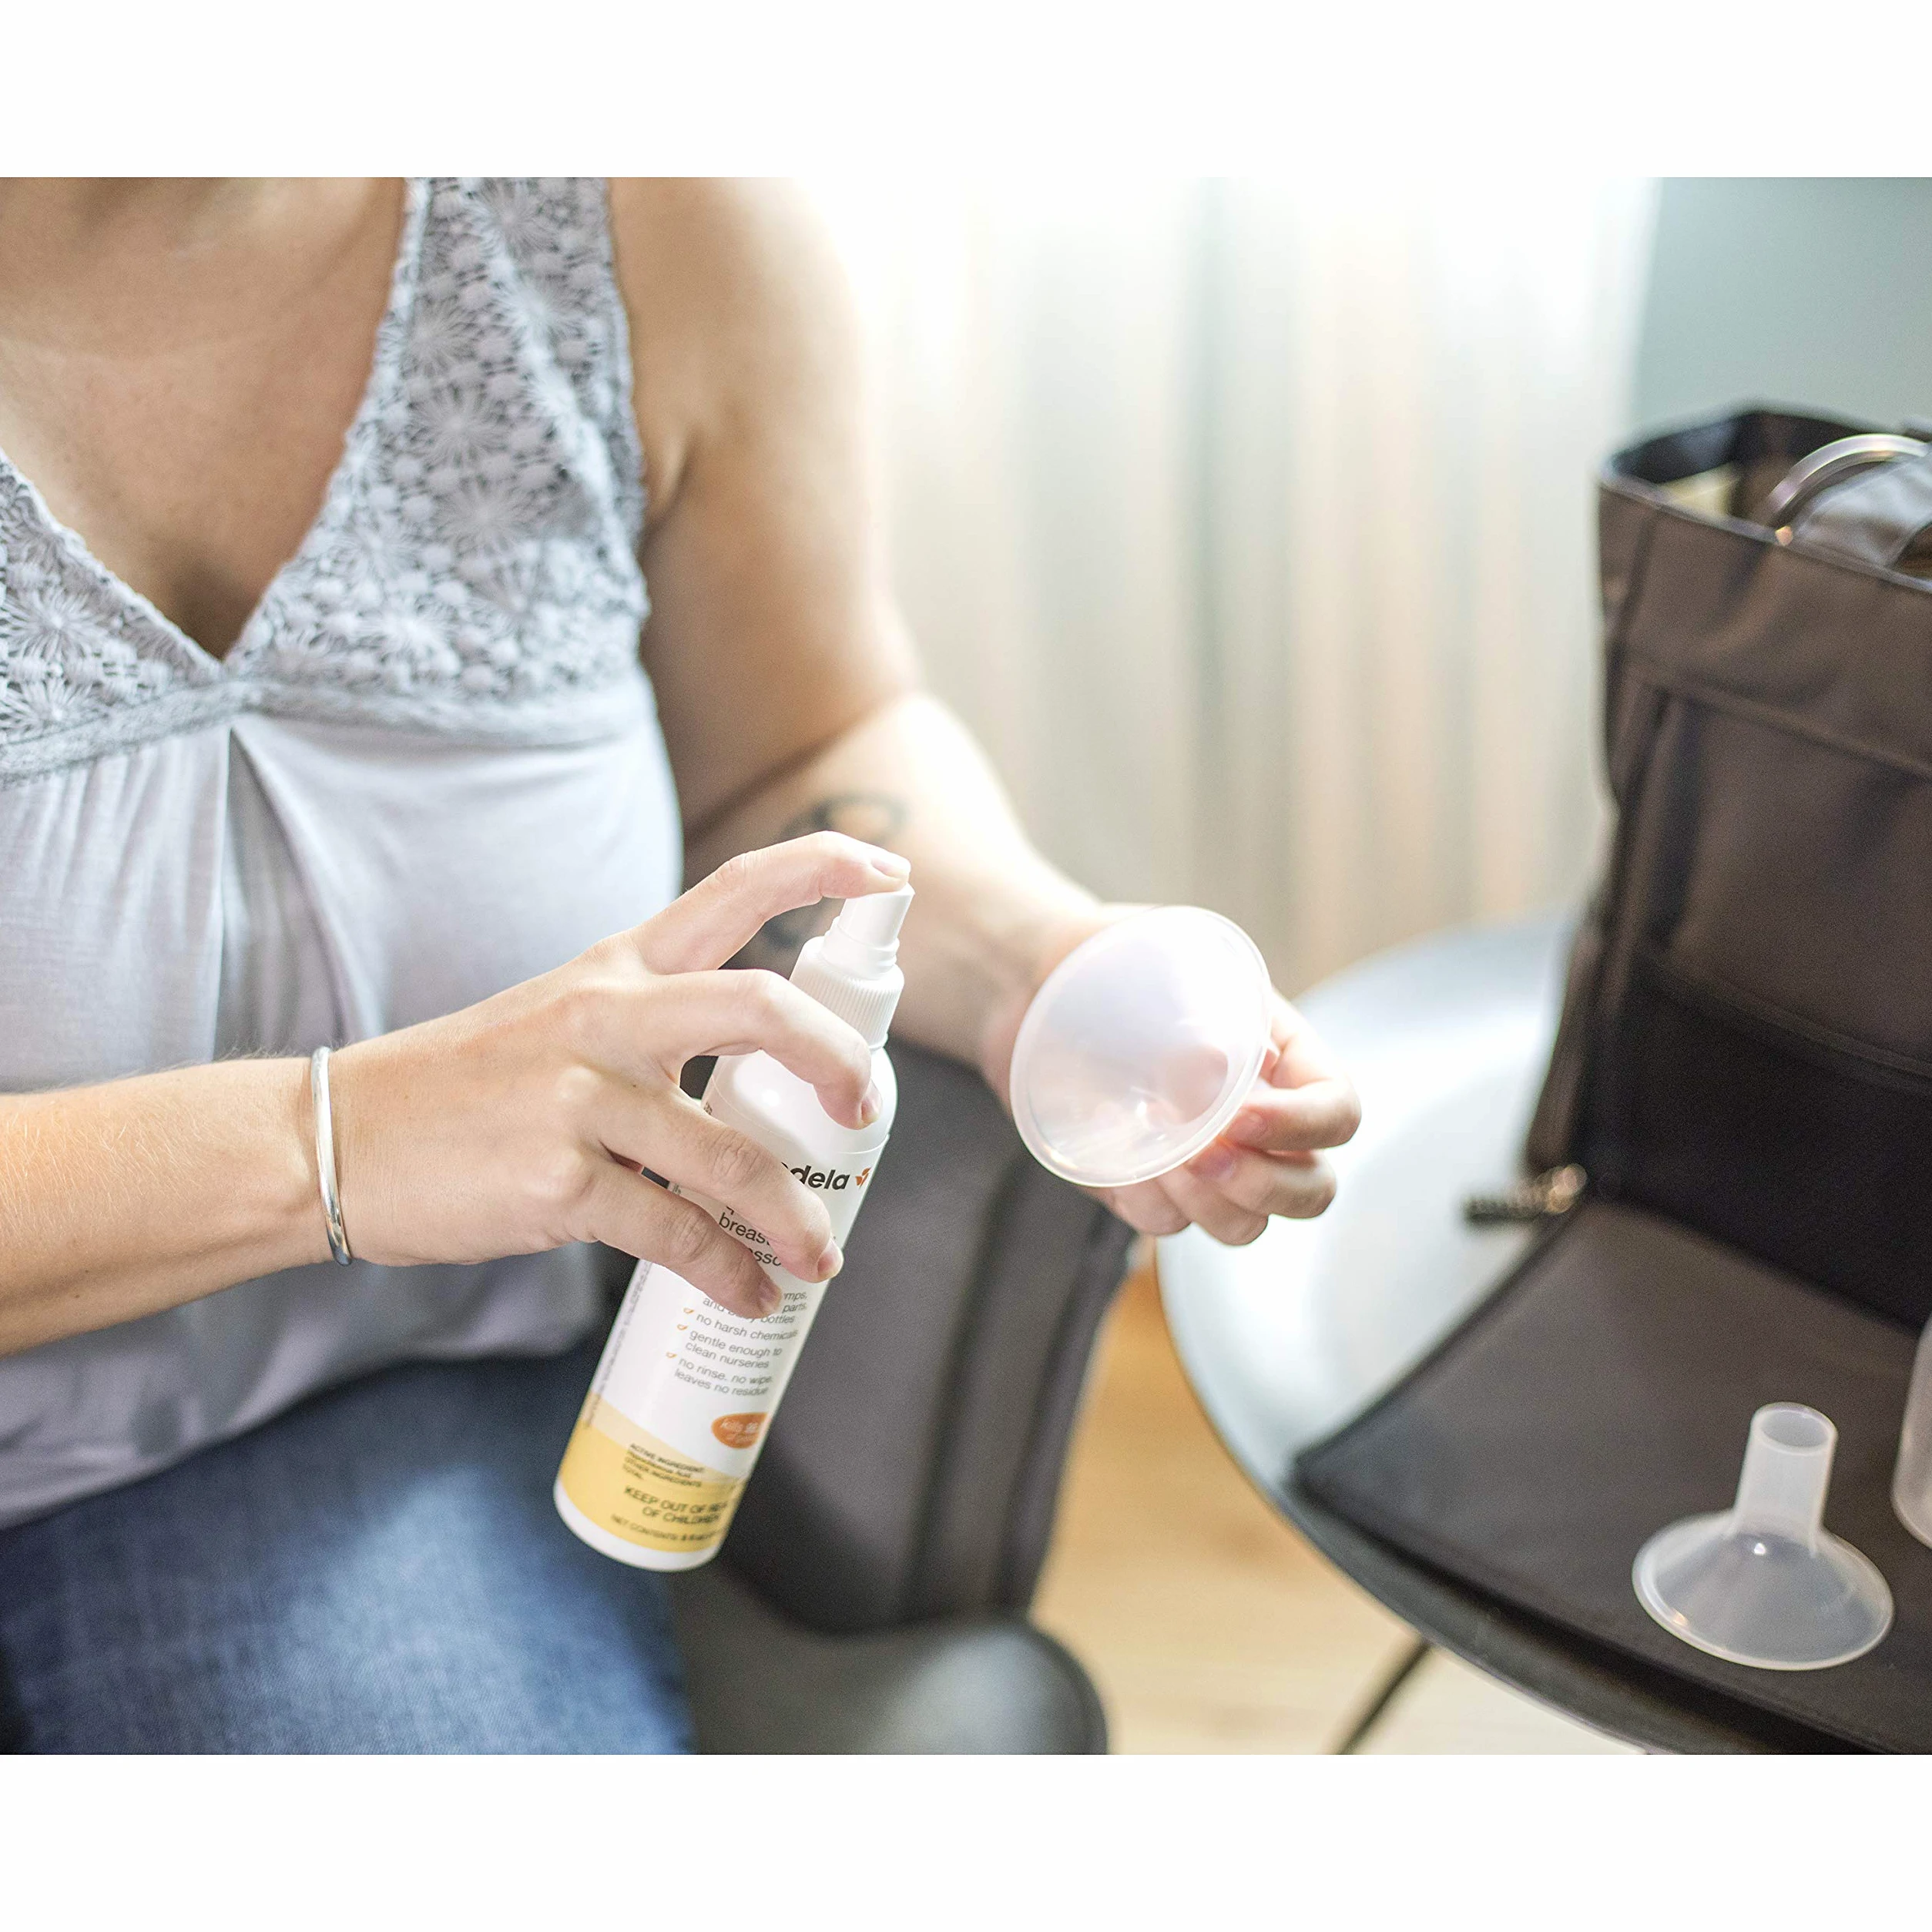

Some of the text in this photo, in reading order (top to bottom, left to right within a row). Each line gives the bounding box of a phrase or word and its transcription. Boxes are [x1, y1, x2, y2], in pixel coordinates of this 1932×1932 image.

[781, 1161, 850, 1190] dela
[719, 1212, 771, 1246] breas
[784, 1291, 807, 1301] mps,
[696, 1313, 713, 1327] no
[714, 1320, 747, 1338] harsh
[685, 1340, 770, 1369] clean nurseries
[689, 1330, 783, 1359] gentle enough to
[674, 1367, 770, 1397] leaves no residue
[679, 1357, 695, 1370] no
[731, 1374, 747, 1385] no
[623, 1485, 658, 1504] KEEP
[660, 1499, 689, 1512] OUT
[689, 1503, 707, 1514] OF
[642, 1506, 660, 1518] OF
